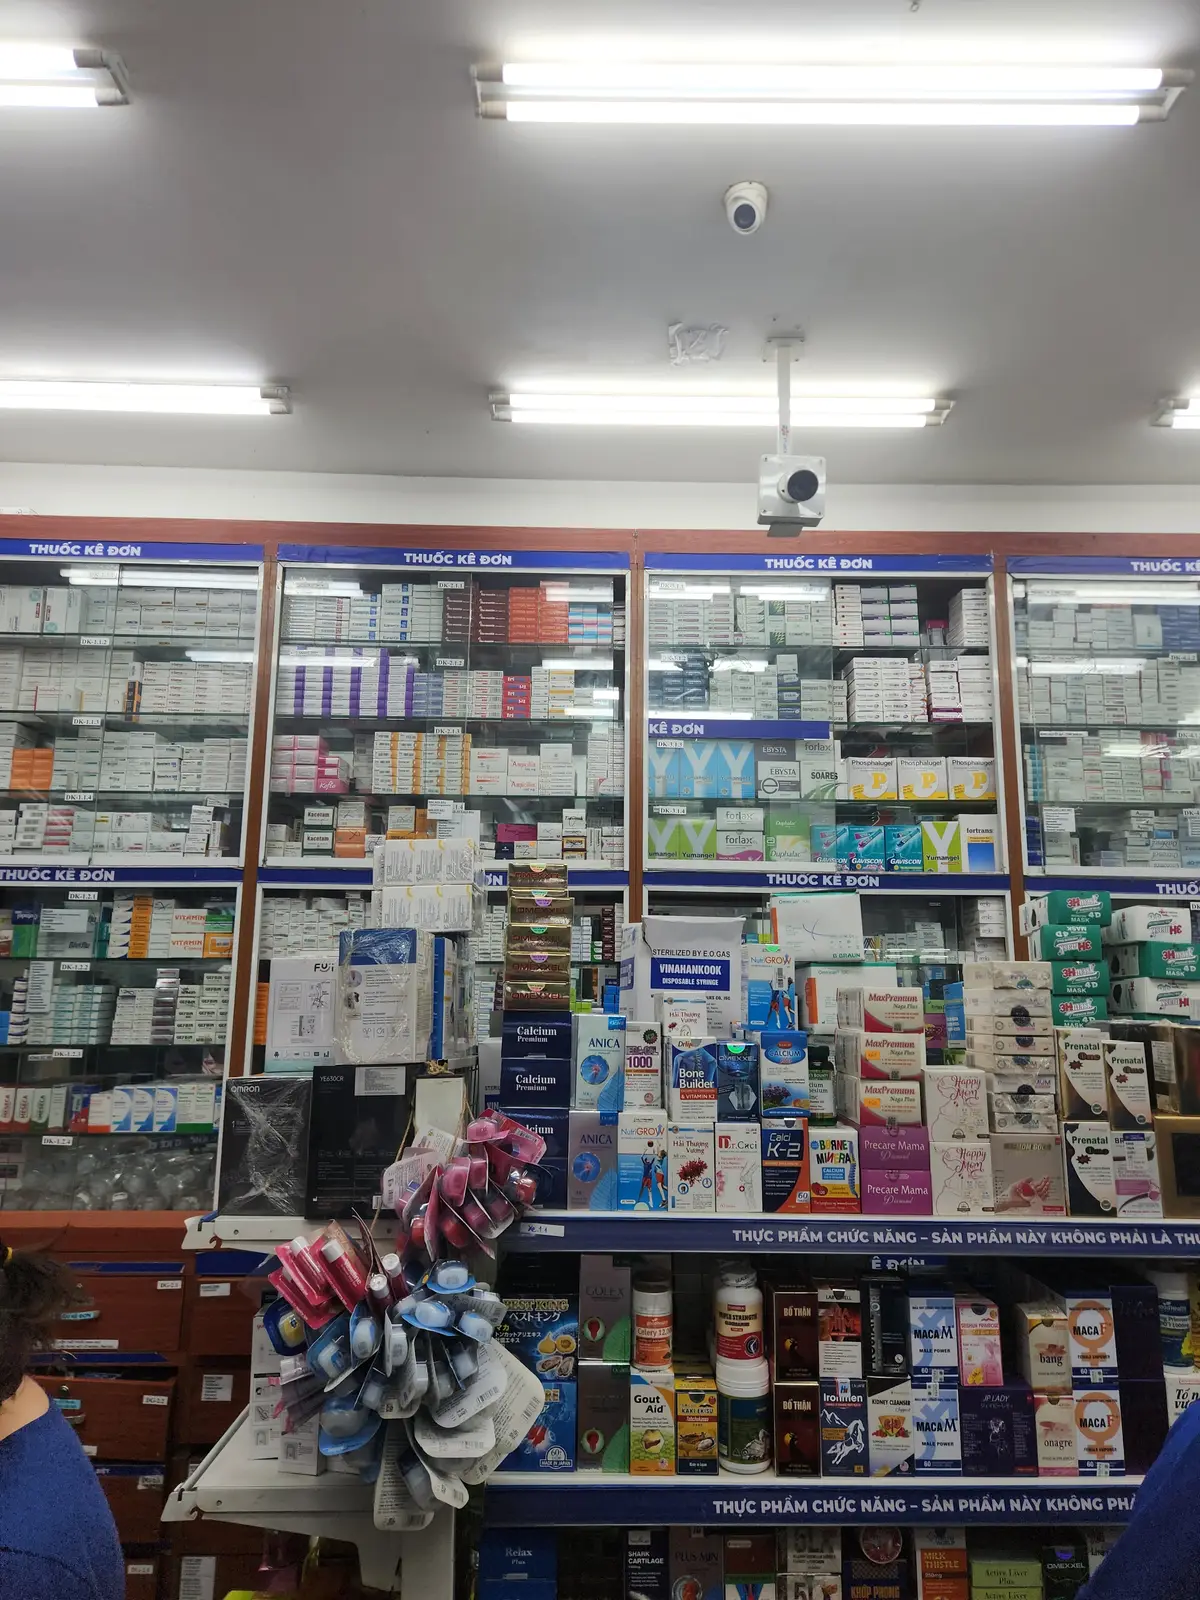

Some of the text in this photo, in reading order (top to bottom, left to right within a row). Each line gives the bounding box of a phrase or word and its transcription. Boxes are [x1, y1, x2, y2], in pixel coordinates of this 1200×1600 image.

[29, 542, 141, 556] THUỐC KÊ ĐƠN
[403, 550, 512, 566] THUỐC KÊ ĐƠN
[765, 555, 873, 569] THUỐC KÊ ĐƠN
[1130, 558, 1182, 572] THUỐC
[649, 722, 704, 735] KÊ ĐƠN
[804, 742, 831, 751] forlax
[851, 759, 894, 768] Phosphalugel
[952, 759, 994, 767] Phosphalugel
[811, 771, 839, 780] SOARES
[725, 811, 753, 820] forlax
[725, 835, 753, 844] forlax
[851, 857, 885, 865] GAVISCON
[55, 867, 76, 881] KÊ
[79, 869, 115, 881] ĐƠN
[766, 870, 880, 887] THUỐC KÊ ĐƠN
[1156, 881, 1200, 895] THUỐ
[652, 949, 691, 957] STERILIZED
[702, 950, 731, 958] E.O.GAS
[659, 963, 722, 976] VINAHANKOOK
[662, 977, 719, 986] DISPOSABLE SYRINGE
[517, 1026, 557, 1036] Calcium
[517, 1035, 548, 1043] Premium
[588, 1038, 620, 1048] ANICA
[1064, 1042, 1100, 1050] Prenatal
[626, 1056, 653, 1068] 1000
[1111, 1056, 1144, 1064] Prenatal
[679, 1068, 705, 1078] Bone
[515, 1075, 556, 1084] Calcium
[679, 1079, 715, 1089] Builder
[951, 1075, 982, 1089] Happy
[230, 1085, 260, 1093] OMRON
[580, 1134, 612, 1145] ANICA
[769, 1132, 791, 1142] Calci
[1071, 1135, 1109, 1145] Prenatal
[767, 1142, 801, 1157] K-2
[864, 1140, 925, 1150] Precare Mama
[956, 1147, 987, 1161] Happy
[867, 1184, 928, 1195] Precare Mama
[732, 1226, 1172, 1245] THỰC PHẨM CHỨC NĂNG SẢN PHẨM NÀY KHÔNG PHẢI LÀ
[534, 1298, 569, 1312] KING
[509, 1311, 562, 1322] ベストキング
[637, 1327, 657, 1336] Celery
[914, 1325, 953, 1339] MACA M
[1073, 1326, 1100, 1336] MACA
[1039, 1353, 1063, 1365] bang
[1175, 1387, 1188, 1400] Tố
[634, 1394, 661, 1404] Gout
[645, 1404, 664, 1414] Aid
[916, 1418, 957, 1432] MACA M
[1079, 1418, 1106, 1428] MACA
[1044, 1438, 1073, 1450] onagre
[712, 1493, 1136, 1517] THỰC PHẨM CHỨC NĂNG SẢN PHẨM NÀY KHÔNG PHẢ
[504, 1547, 533, 1557] Relax
[628, 1550, 650, 1558] SHARK
[924, 1552, 946, 1560] MILK
[628, 1557, 665, 1565] CARTILAGE
[925, 1560, 960, 1569] THISTLE
[1047, 1562, 1086, 1570] OMEXXEL
[985, 1568, 1028, 1577] Active Liver
[999, 1576, 1015, 1585] Plus
[1008, 1591, 1028, 1600] Liver
